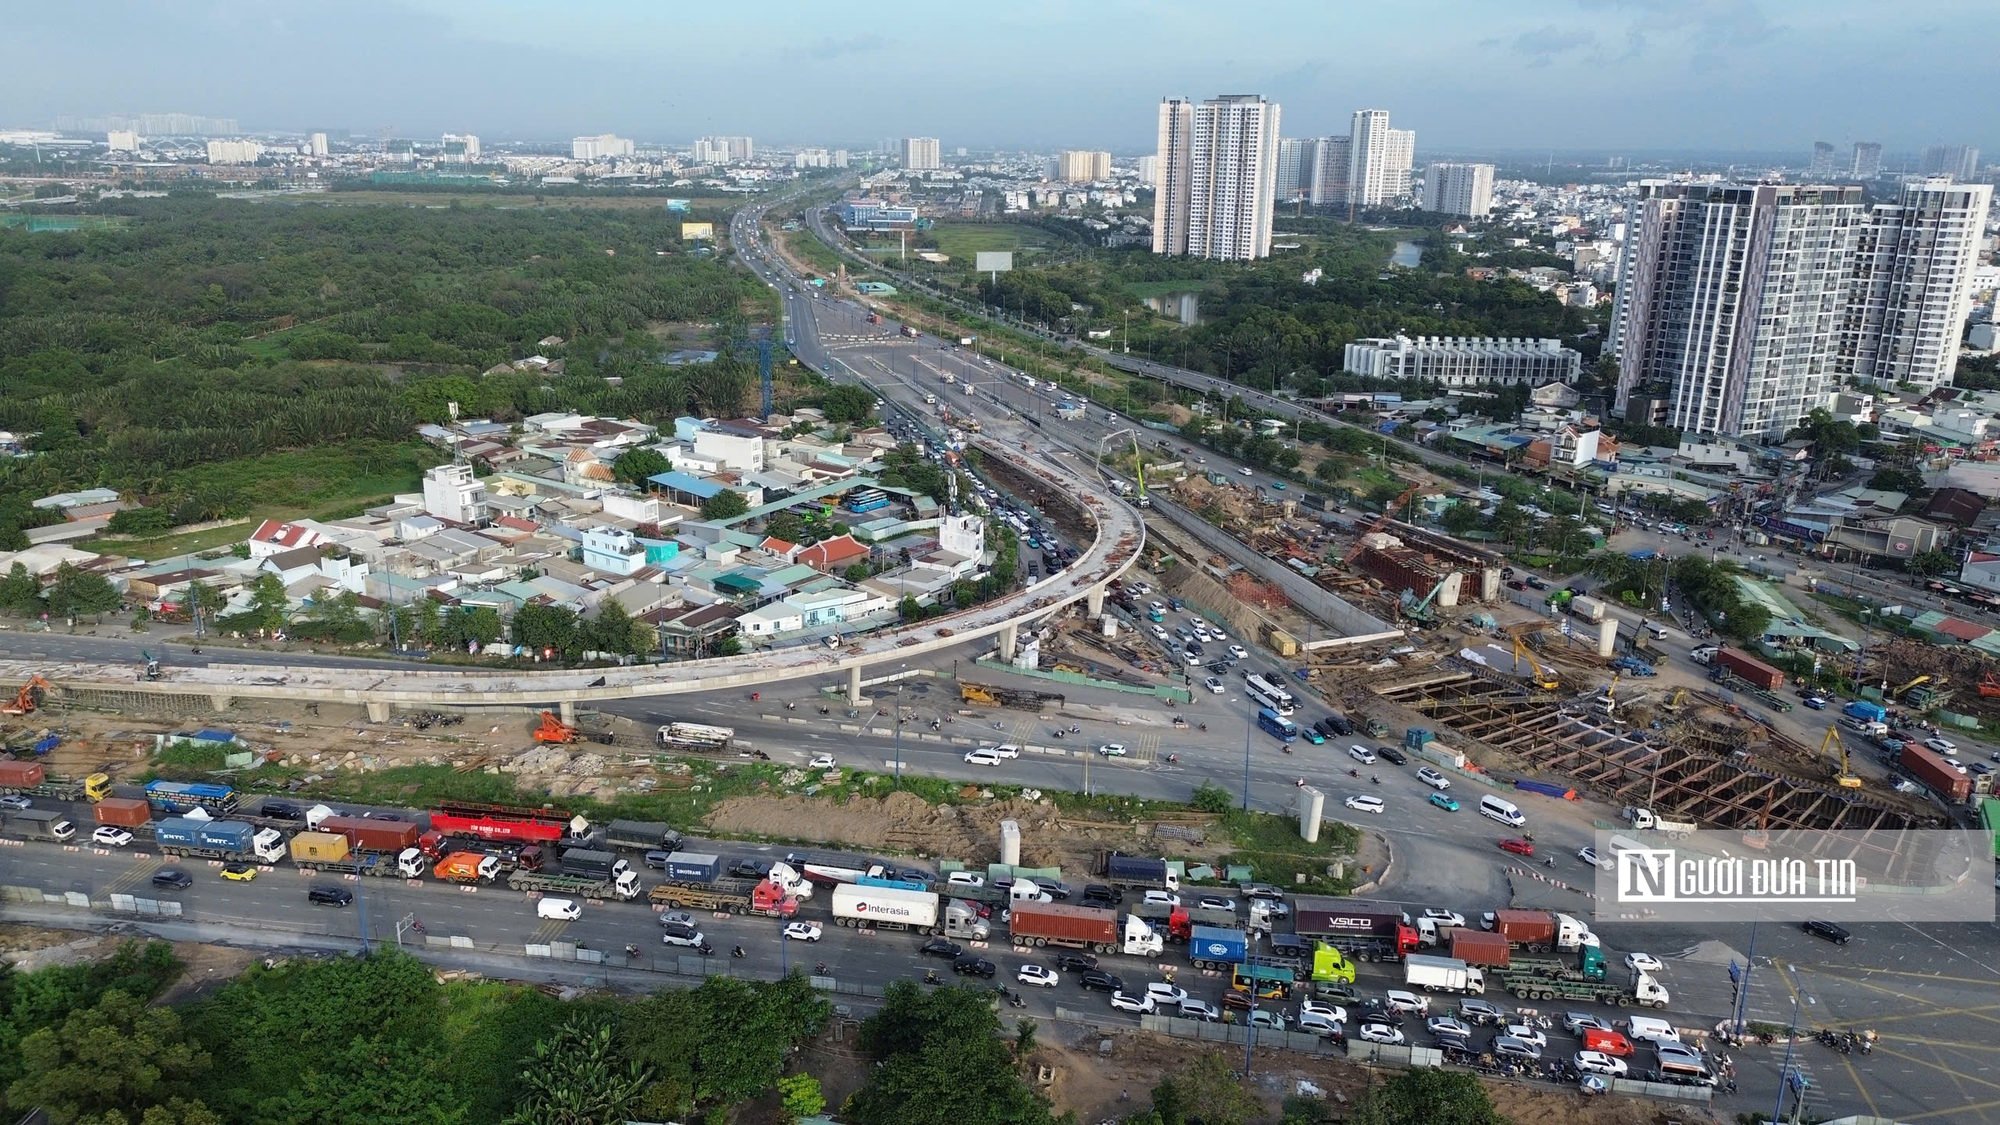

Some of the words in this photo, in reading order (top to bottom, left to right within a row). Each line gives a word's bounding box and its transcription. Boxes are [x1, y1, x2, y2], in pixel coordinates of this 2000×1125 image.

[163, 833, 185, 841] KMTC
[207, 837, 228, 845] KMTC
[676, 868, 702, 877] SINOTRANS
[868, 904, 910, 916] Interasia
